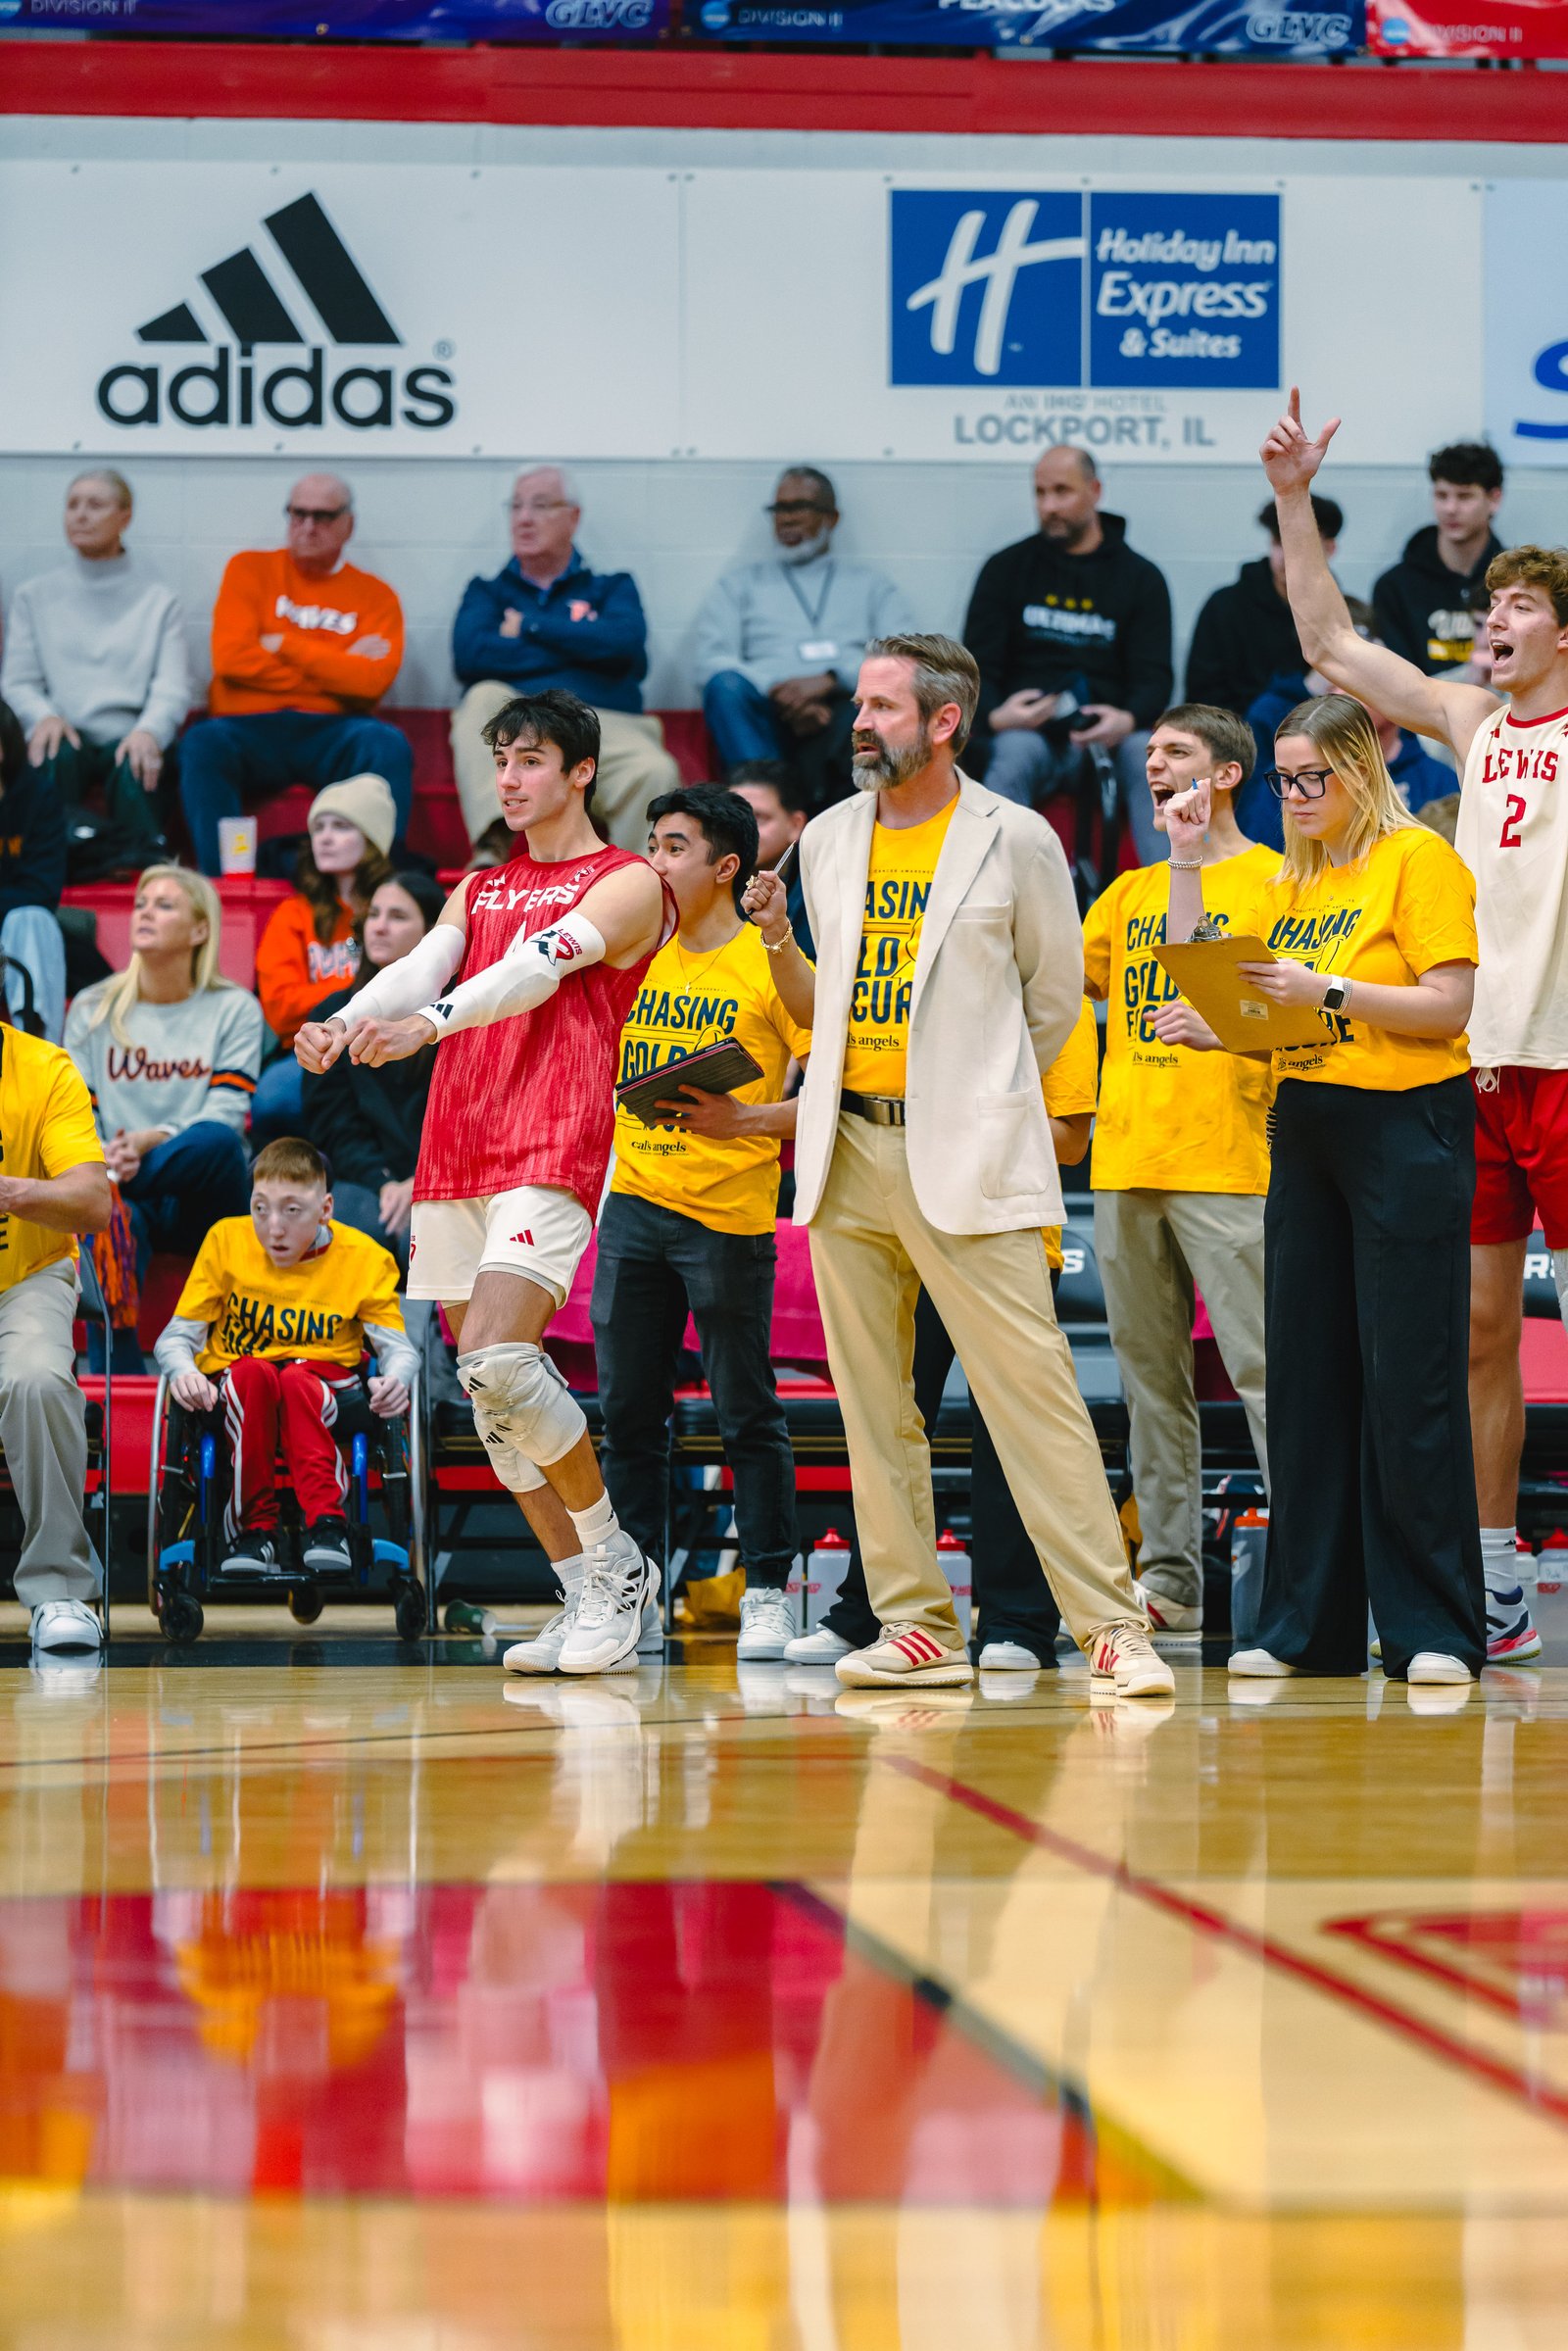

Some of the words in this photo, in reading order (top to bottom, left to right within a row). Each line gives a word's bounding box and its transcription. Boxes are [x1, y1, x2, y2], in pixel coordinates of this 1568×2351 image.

[738, 8, 828, 27] DIVISION
[1246, 11, 1352, 46] GLVC
[1096, 227, 1223, 272] Holiday
[1223, 228, 1276, 265] Inn
[1097, 270, 1268, 328] Express
[1119, 326, 1148, 358] &
[1148, 326, 1243, 359] Suites
[98, 346, 455, 427] adidas
[1092, 394, 1168, 414] HOTEL
[954, 414, 1172, 451] LOCKPORT,
[1182, 417, 1217, 447] IL
[1482, 748, 1559, 783] LEWIS
[1499, 794, 1527, 849] 2
[470, 882, 581, 915] FLYERS
[864, 880, 932, 919] ASIN
[557, 928, 583, 956] LEWIS
[852, 980, 913, 1024] CUR
[858, 1035, 900, 1053] angels
[1144, 1053, 1179, 1068] angels
[108, 1046, 213, 1082] Waves
[1288, 1053, 1324, 1072] angels
[652, 1141, 687, 1157] angels
